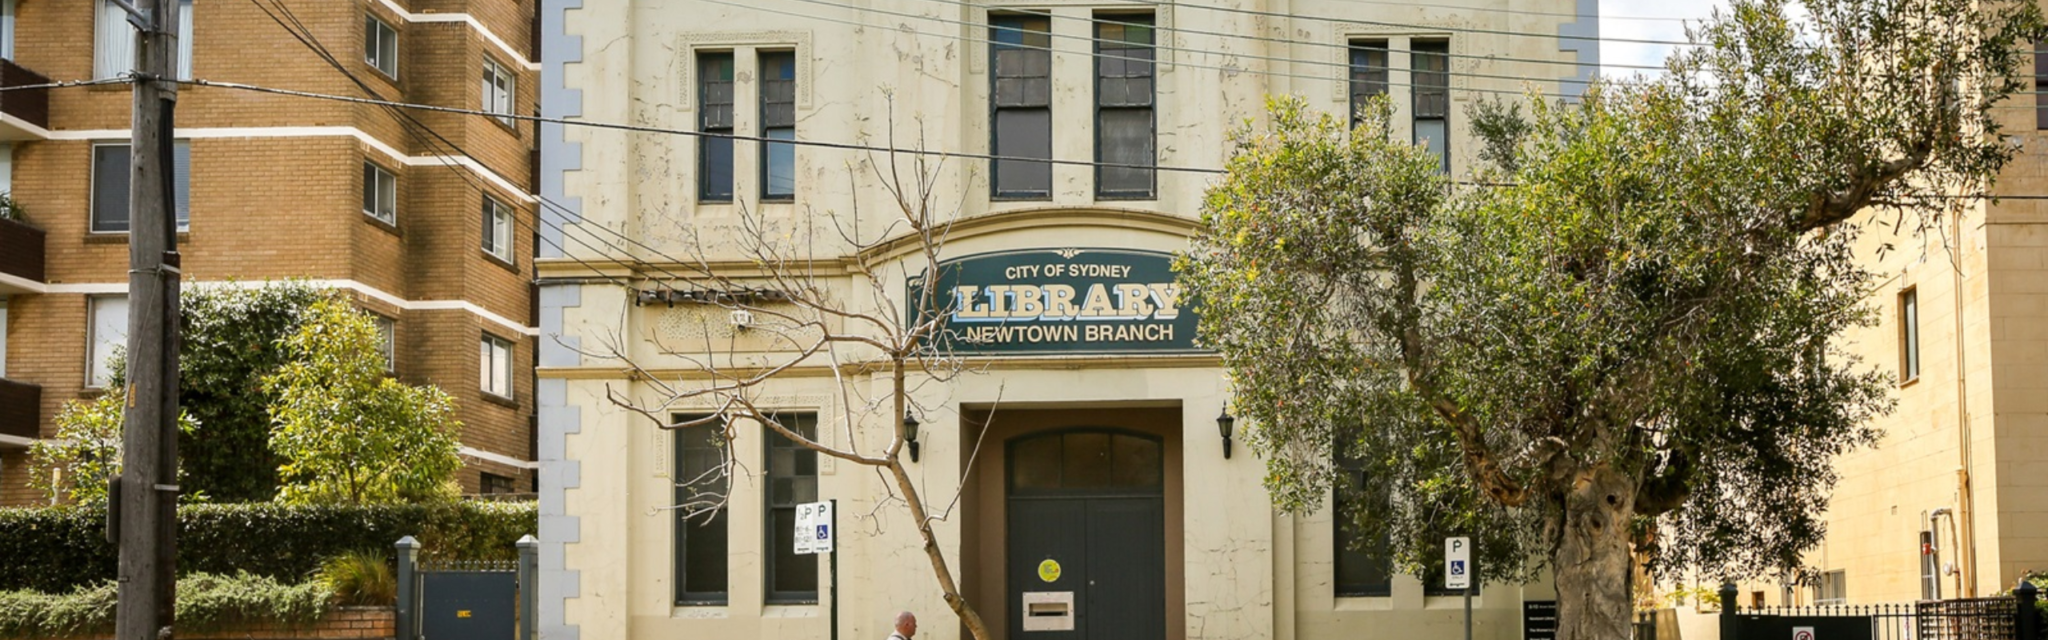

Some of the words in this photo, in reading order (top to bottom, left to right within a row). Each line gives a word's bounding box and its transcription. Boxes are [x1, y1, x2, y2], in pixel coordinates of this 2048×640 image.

[1005, 265, 1040, 280] CITY
[1044, 264, 1066, 277] OF
[1069, 264, 1131, 278] SYDNEY
[952, 283, 1180, 322] LIBRARY
[966, 325, 1078, 343] NEWTOWN
[1085, 324, 1174, 341] BRANCH
[818, 504, 827, 517] P
[1453, 539, 1462, 552] P
